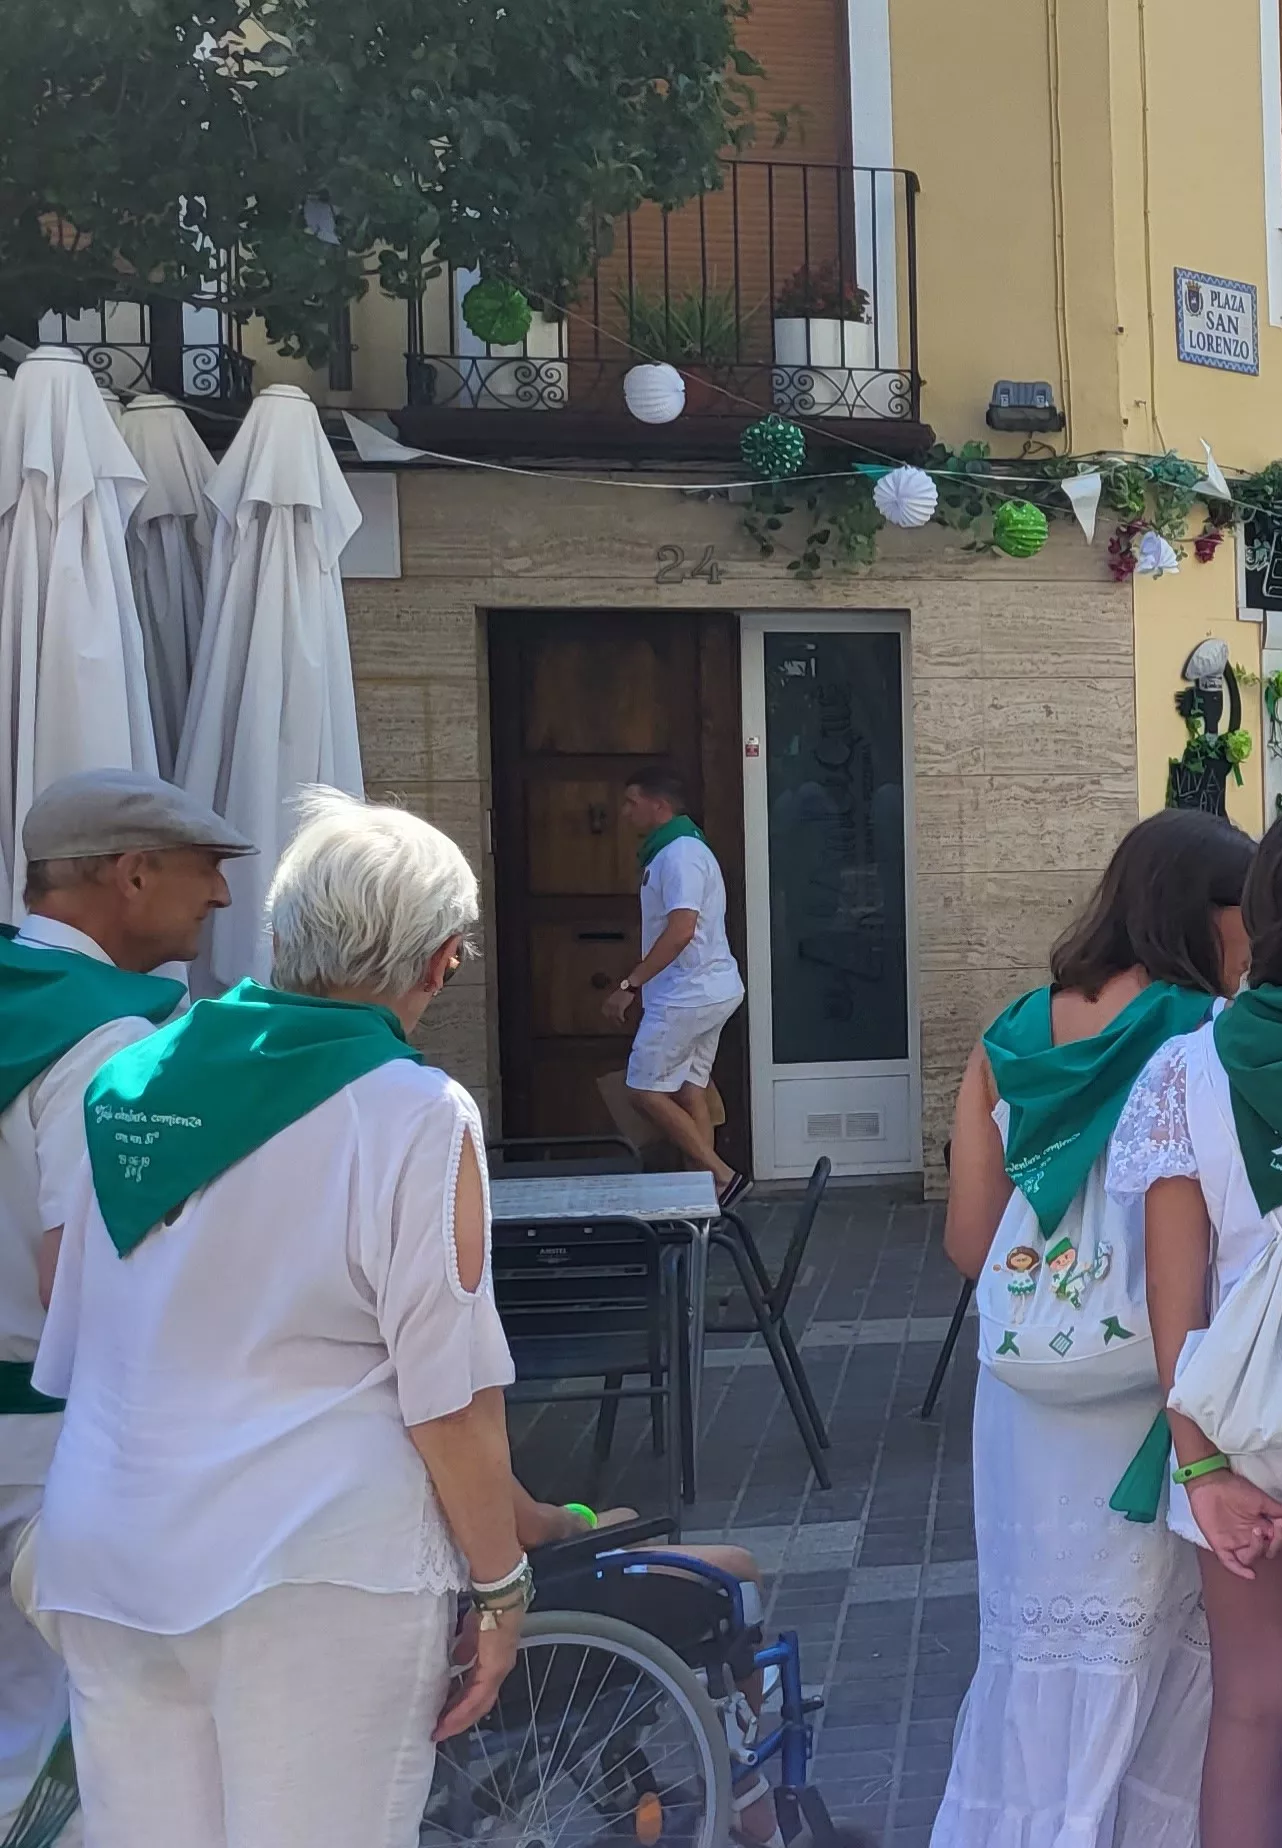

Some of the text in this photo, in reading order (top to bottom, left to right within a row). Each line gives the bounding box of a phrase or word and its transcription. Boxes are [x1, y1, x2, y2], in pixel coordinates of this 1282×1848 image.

[1210, 289, 1246, 314] PLAZA
[1206, 310, 1239, 336] SAN
[1188, 329, 1250, 360] LORENZO
[655, 544, 722, 585] 24
[150, 1114, 202, 1128] comienza
